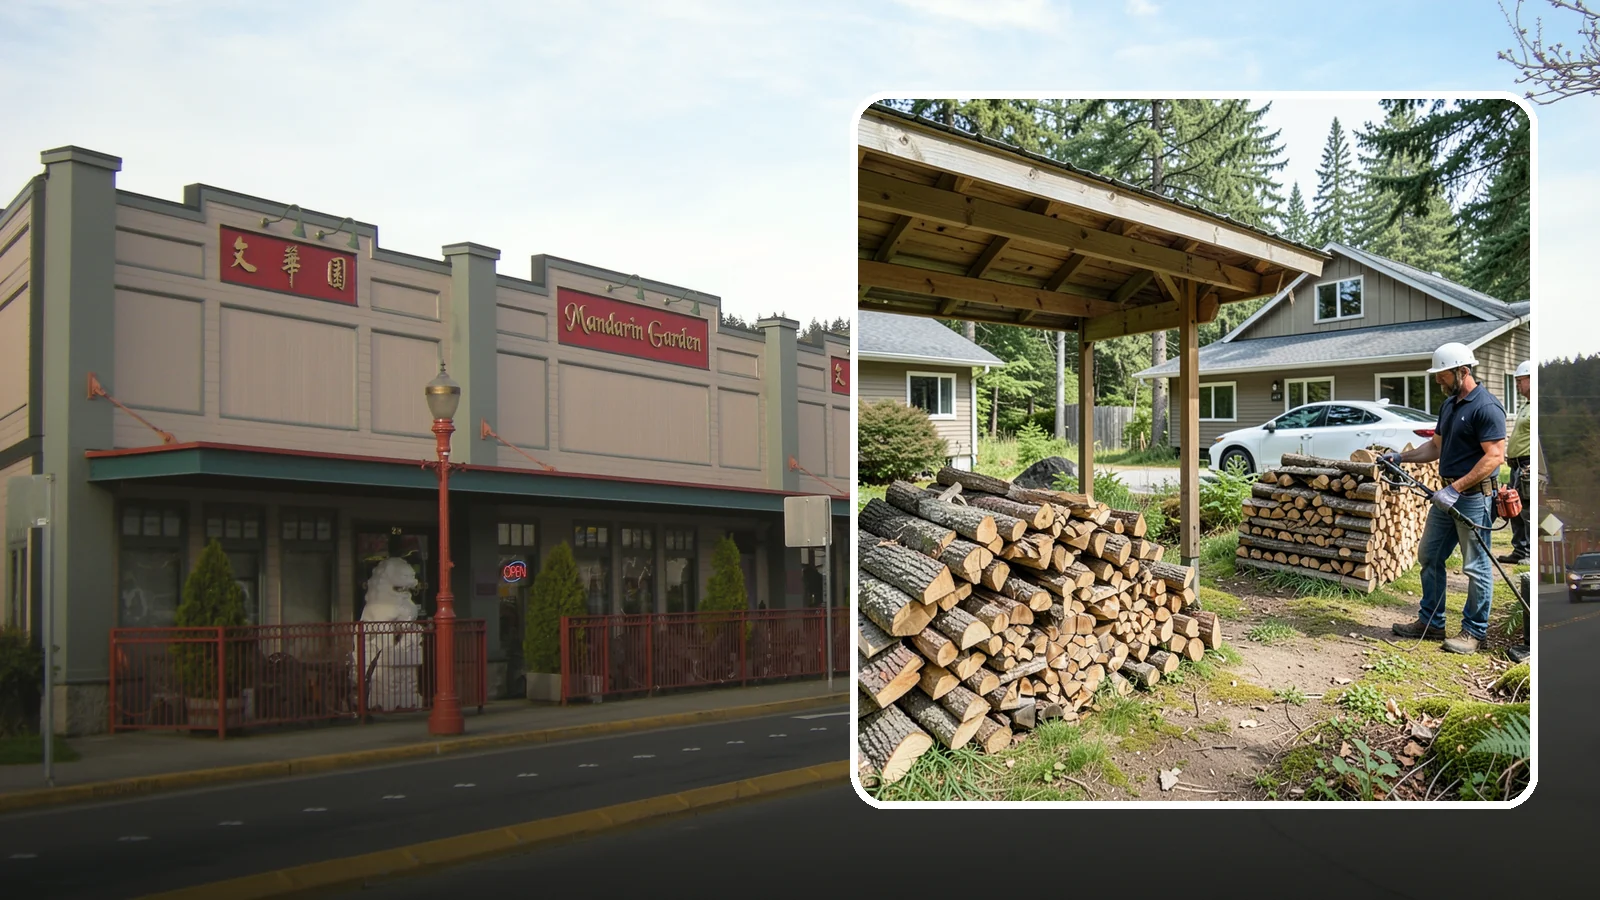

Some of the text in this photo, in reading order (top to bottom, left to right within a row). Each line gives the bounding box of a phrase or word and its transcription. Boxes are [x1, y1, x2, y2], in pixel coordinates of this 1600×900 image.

[230, 235, 347, 291] 文華園
[564, 302, 702, 352] Mandarin Garden
[503, 565, 527, 578] OPEN
